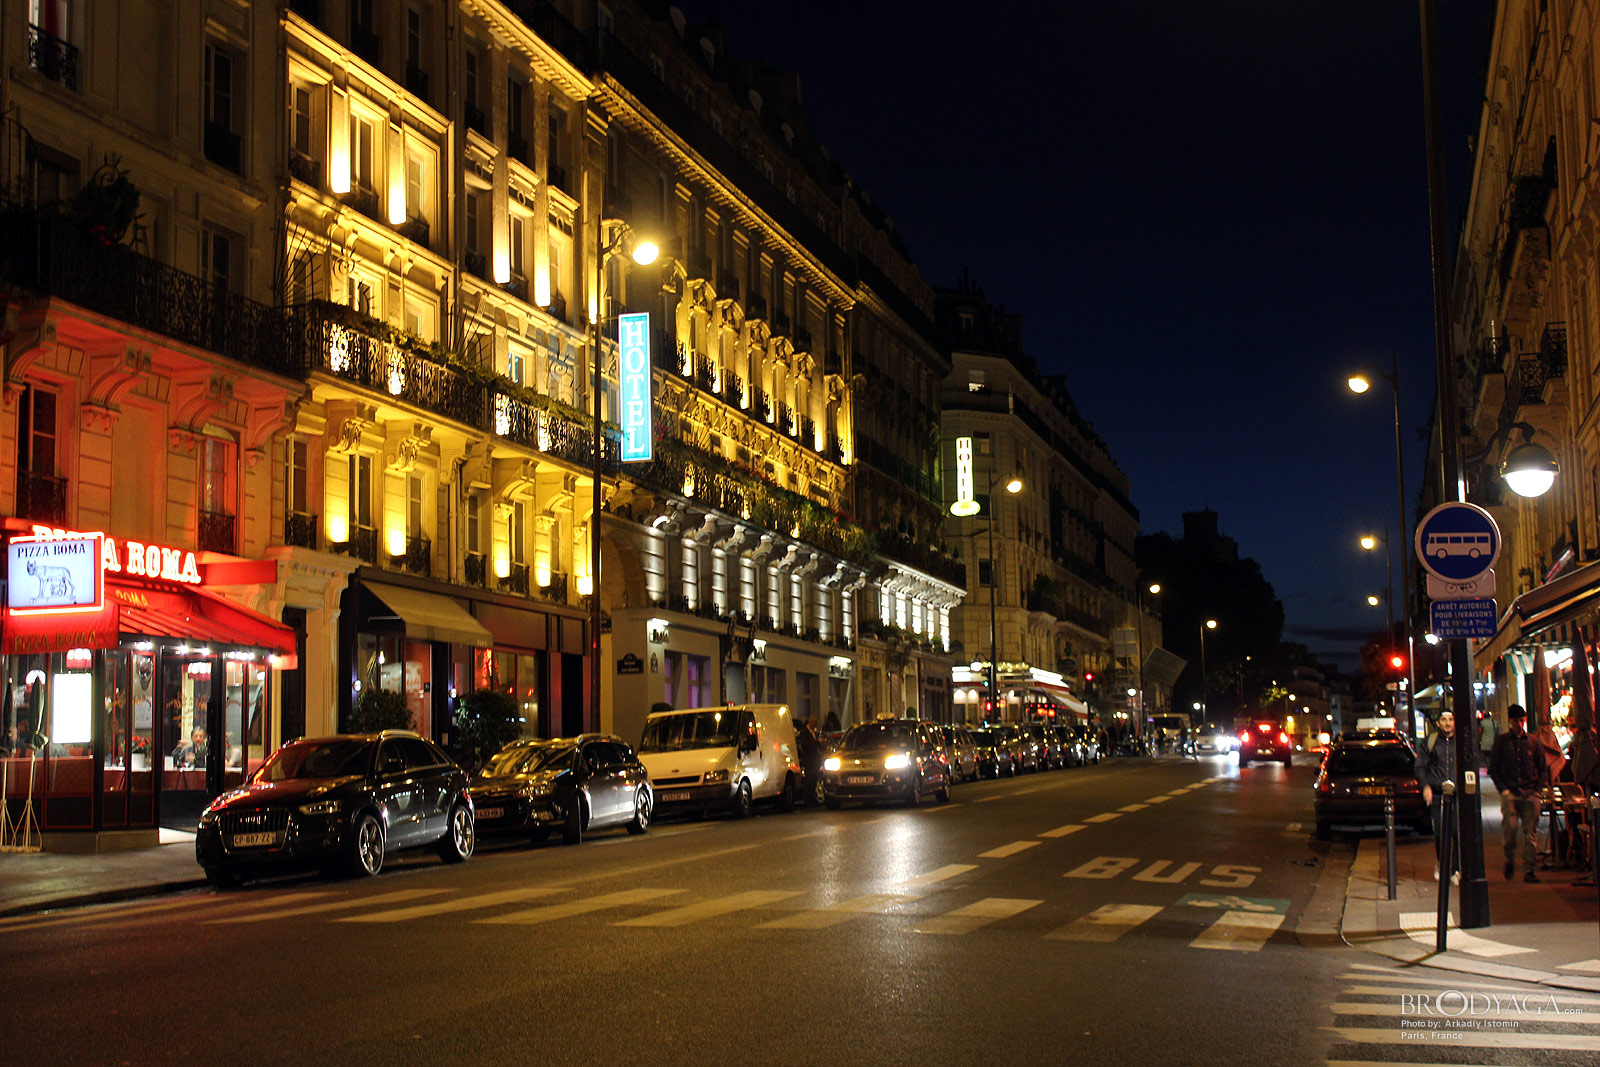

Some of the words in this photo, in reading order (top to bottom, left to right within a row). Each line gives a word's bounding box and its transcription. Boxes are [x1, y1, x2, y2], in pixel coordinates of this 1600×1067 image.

[624, 320, 645, 454] HOTEL
[17, 546, 49, 558] PIZZA
[53, 543, 86, 556] ROMA
[126, 541, 202, 584] ROMA
[1435, 611, 1453, 619] POUR
[1455, 610, 1493, 619] LIVRAISONS
[14, 633, 50, 652] PIZZA
[56, 630, 98, 649] ROMA
[1062, 856, 1262, 888] BUS
